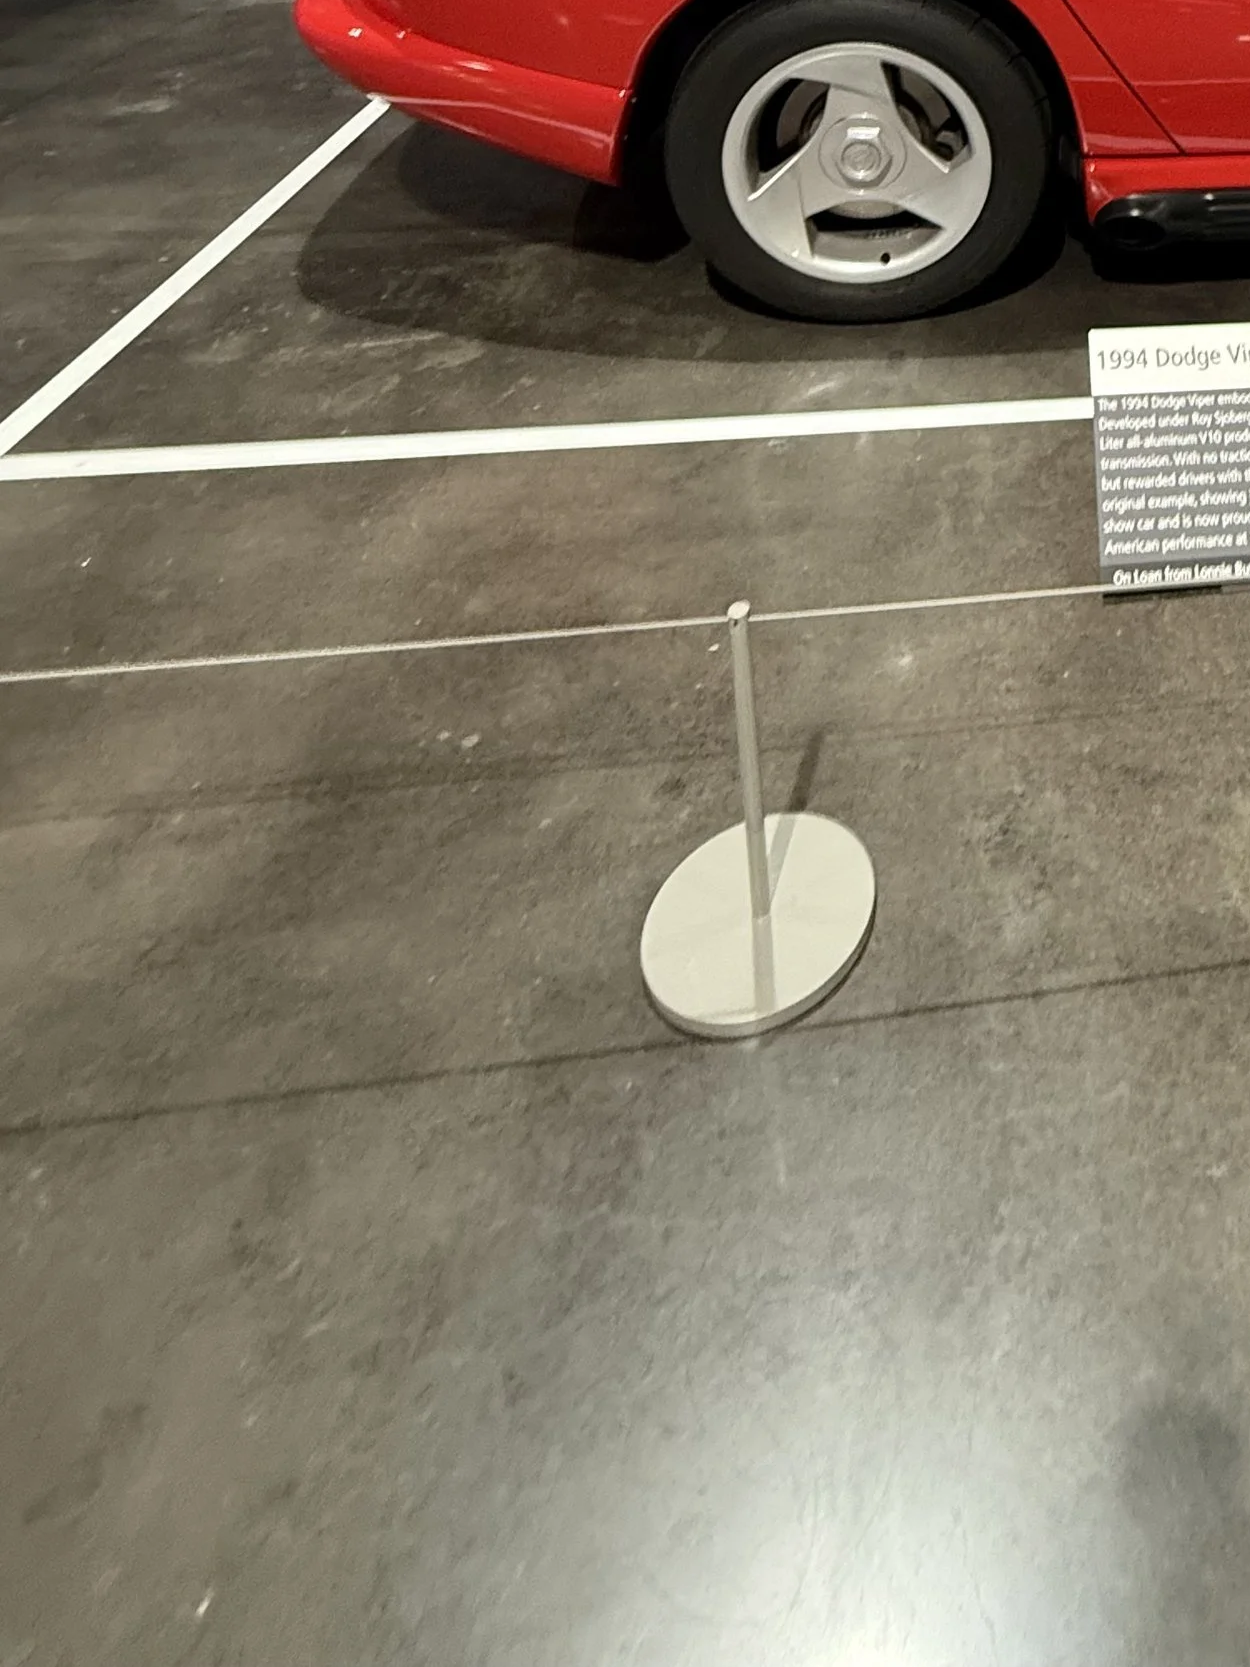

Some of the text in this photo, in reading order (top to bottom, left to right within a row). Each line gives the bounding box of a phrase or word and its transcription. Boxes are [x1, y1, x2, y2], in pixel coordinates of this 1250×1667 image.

[1097, 349, 1148, 369] 1994
[1156, 346, 1220, 370] Dodge
[1098, 398, 1117, 411] The
[1120, 395, 1148, 410] 1994
[1150, 395, 1186, 410] Dodge
[1186, 393, 1214, 408] Viper
[1097, 414, 1155, 431] Developed
[1157, 413, 1188, 427] under
[1190, 411, 1212, 427] Roy
[1098, 436, 1123, 450] Liter
[1126, 433, 1197, 448] all-aluminum
[1198, 429, 1222, 444] V10
[1104, 538, 1159, 555] American
[1161, 534, 1232, 553] performance
[1235, 531, 1247, 546] at
[1112, 569, 1131, 587] On
[1132, 569, 1162, 585] Loan
[1163, 565, 1192, 583] from
[1193, 562, 1232, 580] Lonnie
